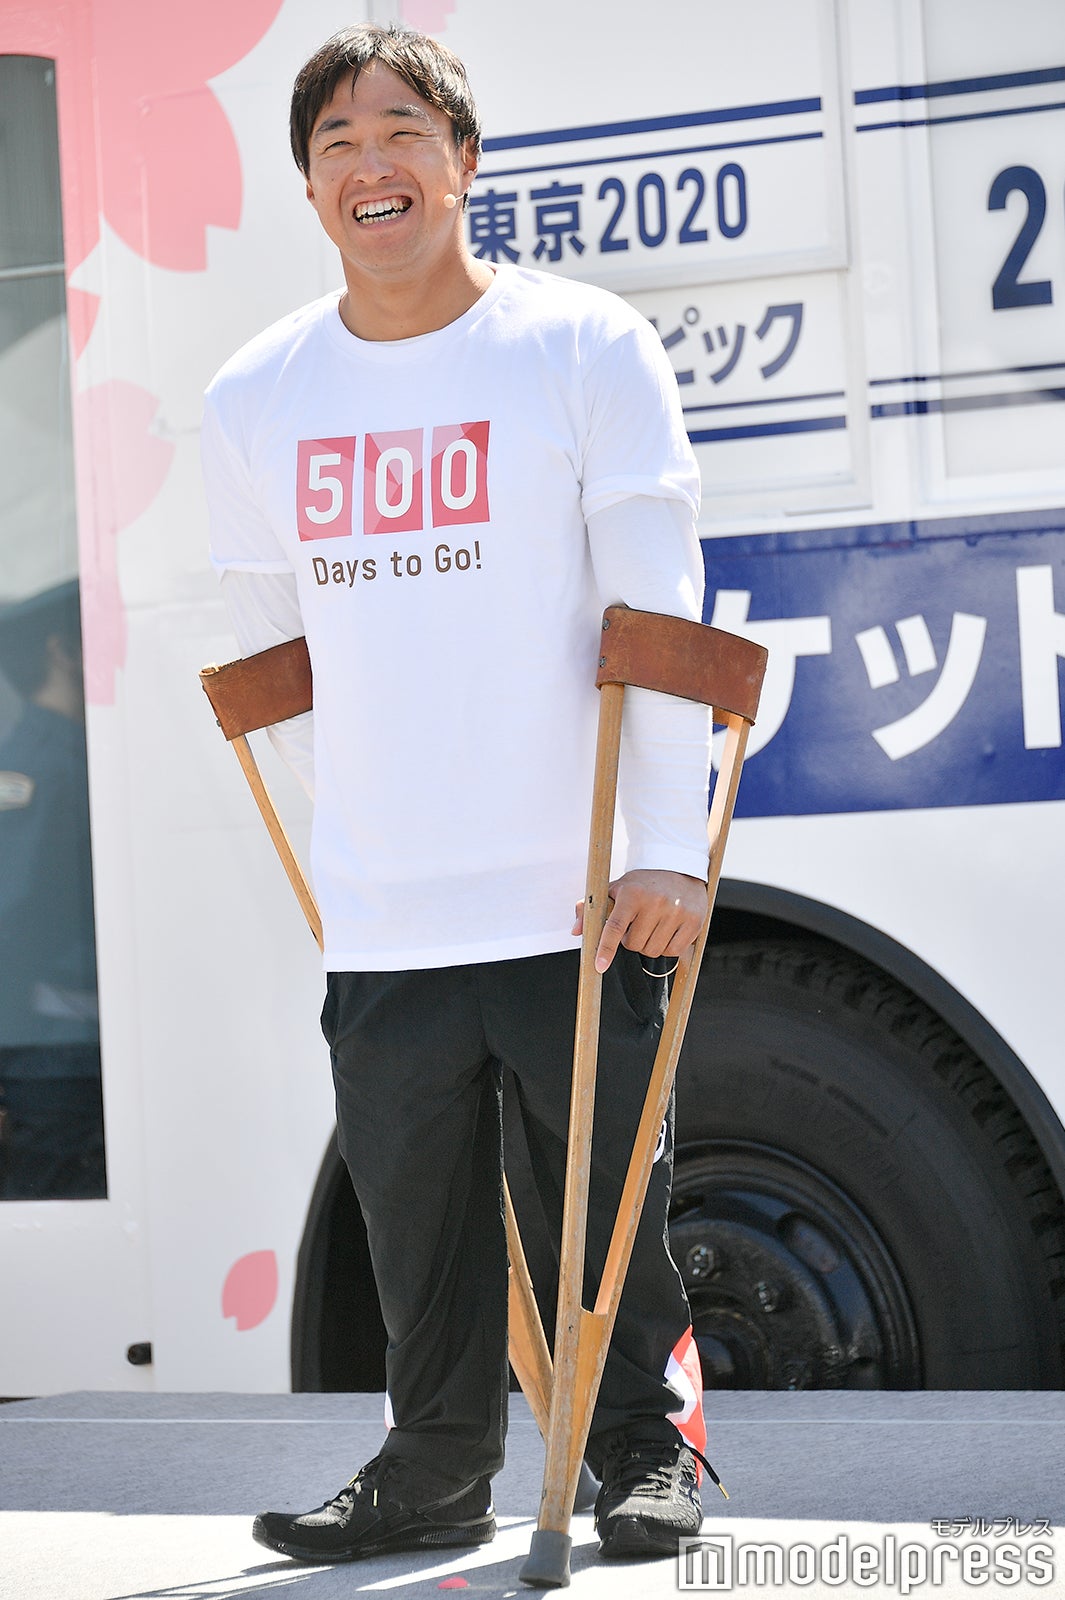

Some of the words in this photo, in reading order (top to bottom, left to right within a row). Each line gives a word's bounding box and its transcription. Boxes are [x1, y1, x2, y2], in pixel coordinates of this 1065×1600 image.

[468, 162, 748, 264] 東京2020
[987, 165, 1065, 310] 2
[650, 302, 804, 384] ピック
[305, 438, 478, 525] 500
[312, 556, 377, 588] Days
[390, 551, 422, 577] to
[434, 540, 482, 573] Go!
